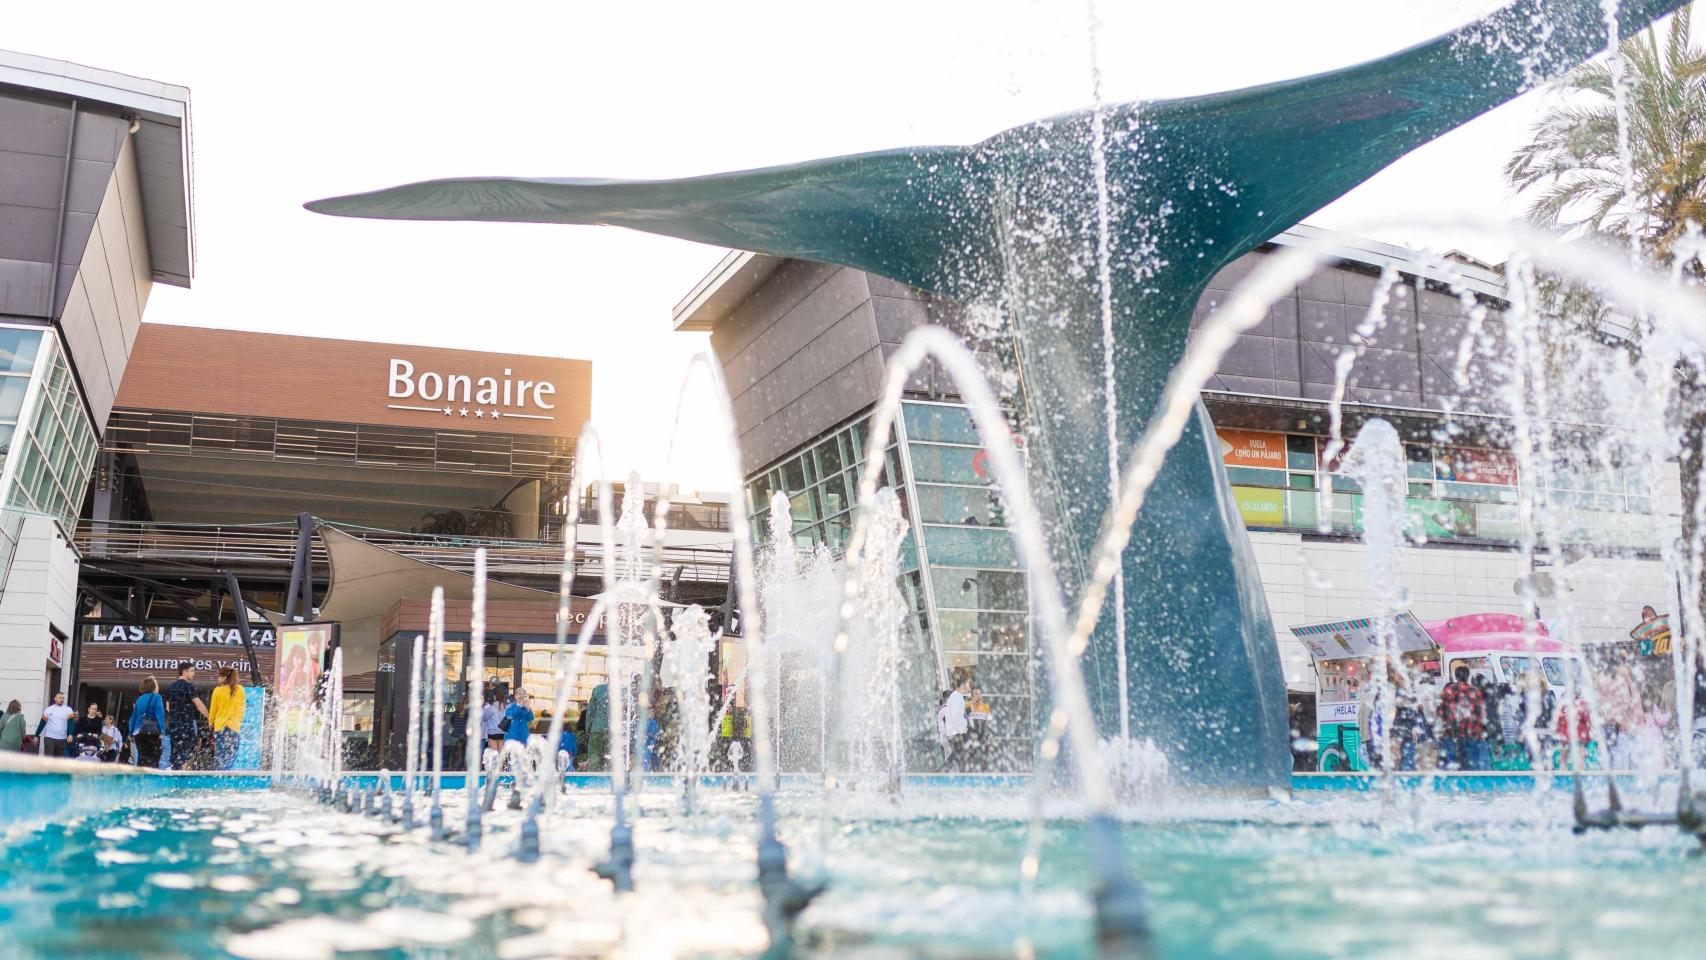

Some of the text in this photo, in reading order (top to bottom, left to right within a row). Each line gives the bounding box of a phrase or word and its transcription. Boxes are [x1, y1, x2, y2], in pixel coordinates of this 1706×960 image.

[388, 358, 556, 409] Bonaire
[1249, 440, 1266, 448] VUELA
[1235, 448, 1251, 458] COMO
[1251, 449, 1260, 458] UN
[93, 625, 144, 641] LAS
[158, 625, 276, 646] TERRAZA
[231, 658, 260, 672] cin
